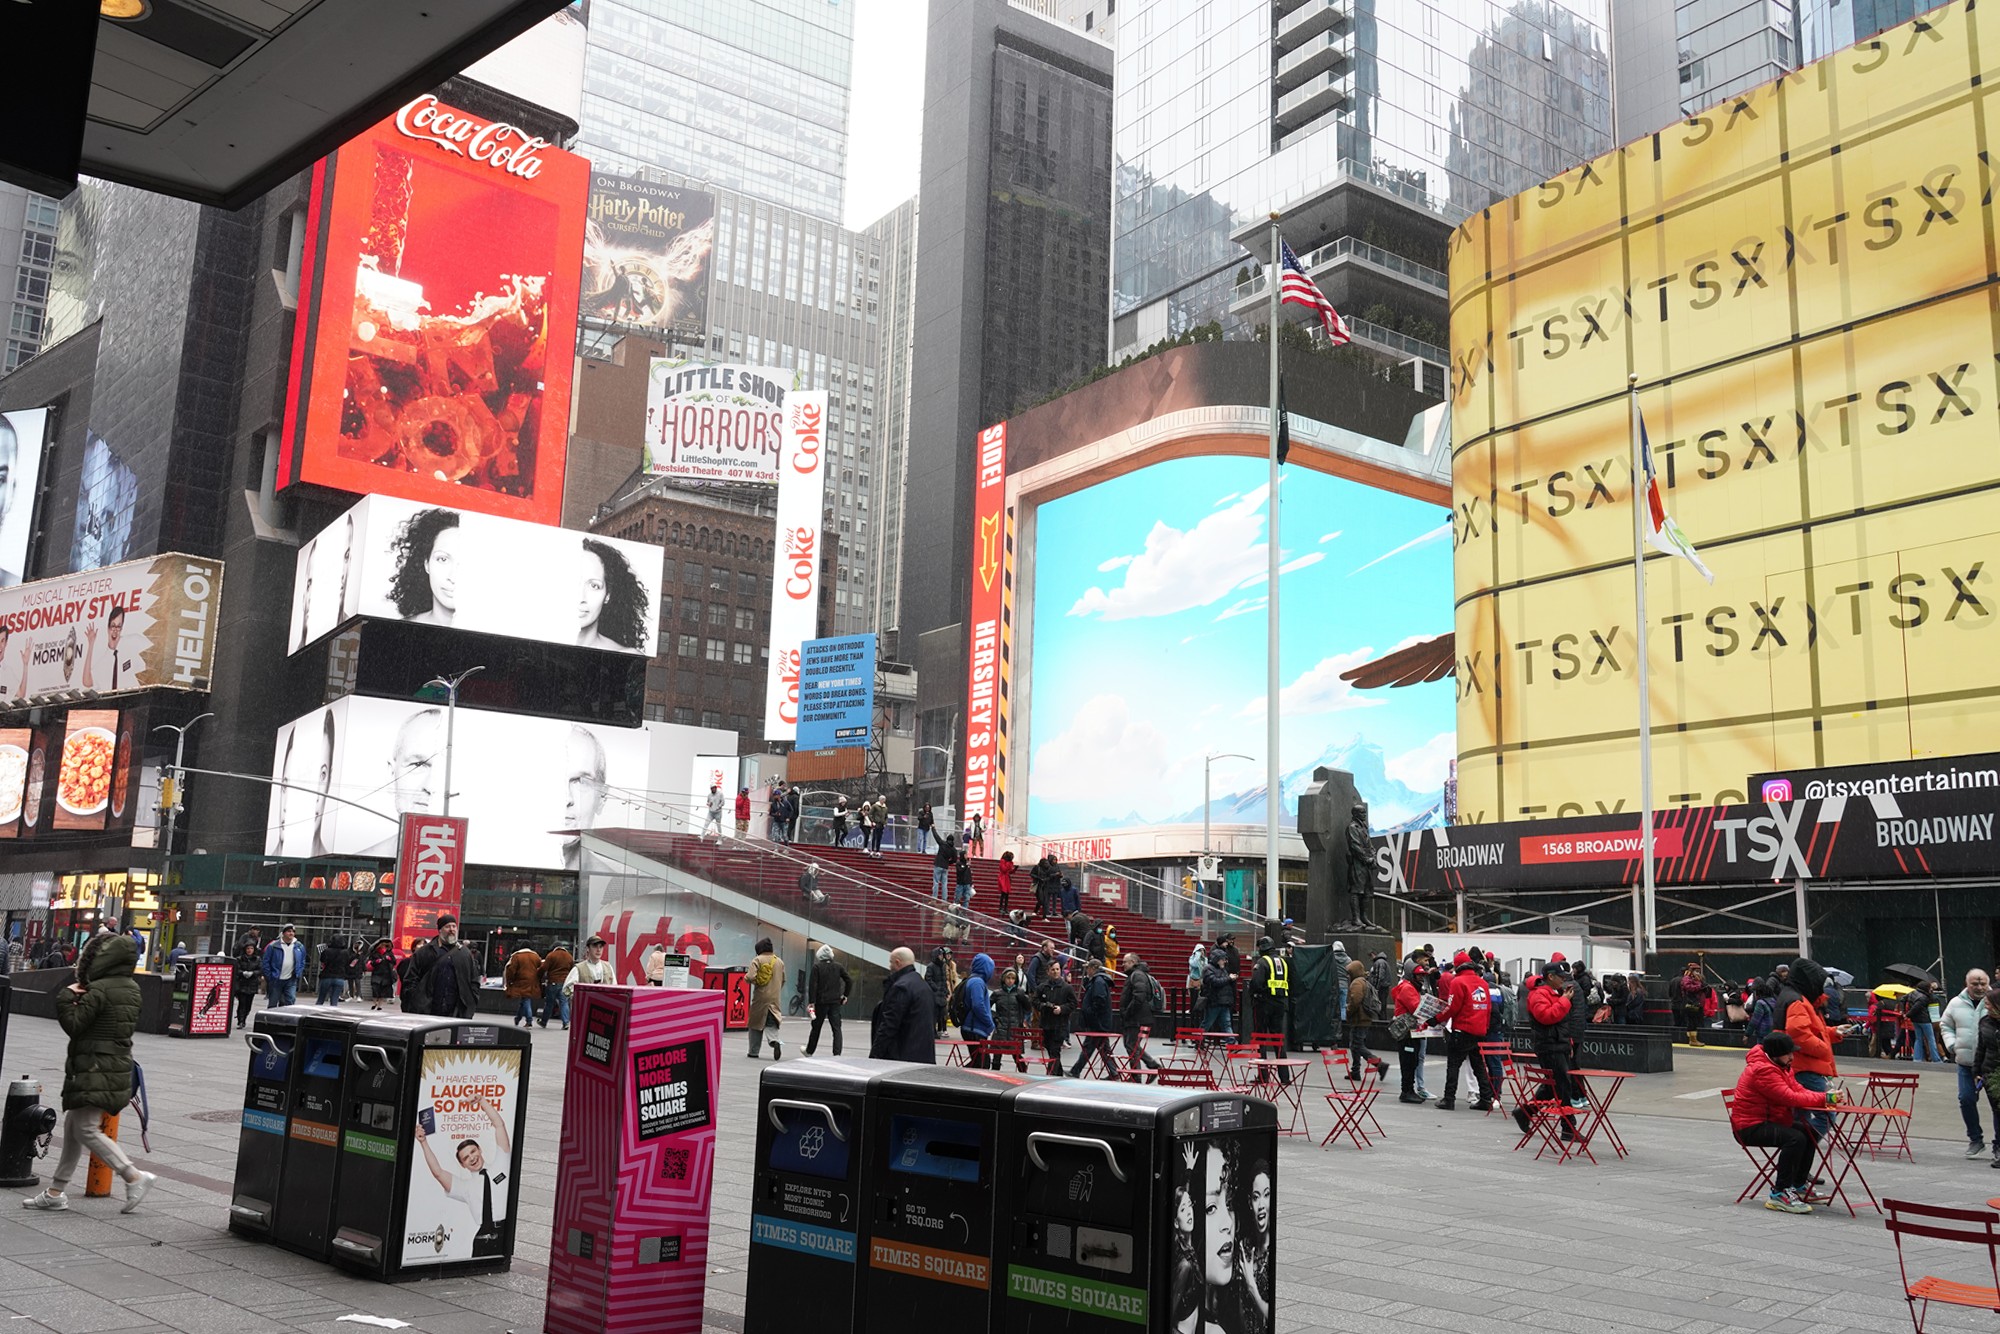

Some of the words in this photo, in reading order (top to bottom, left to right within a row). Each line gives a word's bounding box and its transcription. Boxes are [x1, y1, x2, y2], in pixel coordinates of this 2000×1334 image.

[396, 93, 551, 179] Coca-Cola
[597, 177, 616, 188] ON
[620, 182, 681, 200] BROADWAY
[588, 193, 637, 223] Harry
[636, 198, 686, 230] Potter
[1813, 173, 1959, 266] TSX
[607, 222, 639, 234] CURSED
[640, 226, 666, 238] CHILD
[1647, 241, 1768, 323] TSX
[1508, 298, 1609, 370] TSX
[664, 368, 735, 399] LITTLE
[716, 394, 731, 404] OF
[1824, 363, 1974, 448] TSX
[790, 403, 802, 430] Diet
[660, 402, 783, 470] HORRORS
[793, 402, 821, 474] Coke
[681, 454, 758, 468] LittleShopNYC.com
[981, 424, 1003, 489] SIDE!
[1654, 415, 1778, 489] TSX
[653, 463, 690, 475] Westside
[692, 466, 722, 476] Theatre
[728, 469, 743, 477] 407
[745, 469, 753, 478] W
[755, 470, 774, 480] 43rd
[1511, 458, 1615, 525] TSX
[784, 528, 794, 554] Diet
[786, 527, 815, 600] Coke
[22, 588, 64, 608] MUSICAL
[68, 577, 113, 599] THEATER
[1835, 560, 1989, 636] TSX
[173, 563, 212, 683] HELLO!
[1661, 596, 1788, 663] TSX
[806, 657, 819, 665] JEWS
[821, 655, 833, 664] HAVE
[834, 653, 849, 662] MORE
[850, 652, 864, 660] THAN
[807, 645, 829, 654] ATTACKS
[829, 644, 837, 652] ON
[838, 641, 865, 651] ORTHODOX
[1515, 625, 1622, 685] TSX
[777, 650, 788, 677] Diet
[805, 666, 829, 676] DOUBLED
[829, 663, 855, 674] RECENTLY.
[804, 682, 818, 690] DEAR
[818, 680, 831, 689] NEW
[831, 678, 844, 687] YORK
[804, 693, 823, 701] WORDS
[823, 691, 831, 699] DO
[831, 690, 848, 699] BREAK
[968, 619, 996, 749] HERSHEY'S
[803, 702, 822, 711] PLEASE
[823, 701, 836, 710] STOP
[836, 699, 865, 709] ATTACKING
[803, 714, 813, 722] OUR
[1713, 799, 1814, 880] TSX
[1876, 813, 1994, 847] BROADWAY
[414, 823, 456, 898] tkts
[1067, 838, 1111, 861] LEGENDS
[1437, 843, 1505, 870] BROADWAY
[1542, 843, 1572, 856] 1568
[587, 1032, 595, 1044] IN
[594, 1034, 611, 1050] TIMES
[1582, 1041, 1635, 1056] SQUARE
[585, 1044, 608, 1062] SQUARE
[637, 1048, 688, 1072] EXPLORE
[446, 1075, 468, 1084] HAVE
[470, 1075, 498, 1083] NEVER
[639, 1067, 672, 1088] MORE
[431, 1084, 506, 1098] LAUGHED
[640, 1088, 653, 1104] IN
[654, 1080, 688, 1102] TIMES
[434, 1100, 455, 1113] SO
[443, 1113, 476, 1122] THERE'S
[477, 1113, 490, 1122] NO
[641, 1098, 686, 1121] SQUARE
[244, 1112, 262, 1127] TIMES
[262, 1116, 285, 1131] SQUARE
[291, 1123, 312, 1137] TIMES
[312, 1127, 338, 1142] SQUARE
[440, 1122, 480, 1133] STOPPING
[345, 1134, 367, 1151] TIMES
[368, 1139, 396, 1157] SQUARE
[784, 1183, 813, 1195] EXPLORE
[813, 1187, 832, 1199] NYC'S
[784, 1194, 803, 1203] MOST
[803, 1197, 825, 1208] ICONIC
[784, 1204, 832, 1220] NEIGHBORHOOD
[906, 1204, 916, 1213] GO
[917, 1206, 926, 1215] TO
[905, 1214, 944, 1230] TSQ.ORG
[755, 1222, 797, 1243] TIMES
[800, 1231, 853, 1256] SQUARE
[873, 1245, 920, 1268] TIMES
[924, 1255, 986, 1282] SQUARE
[1012, 1273, 1067, 1301] TIMES
[1071, 1284, 1143, 1316] SQUARE
